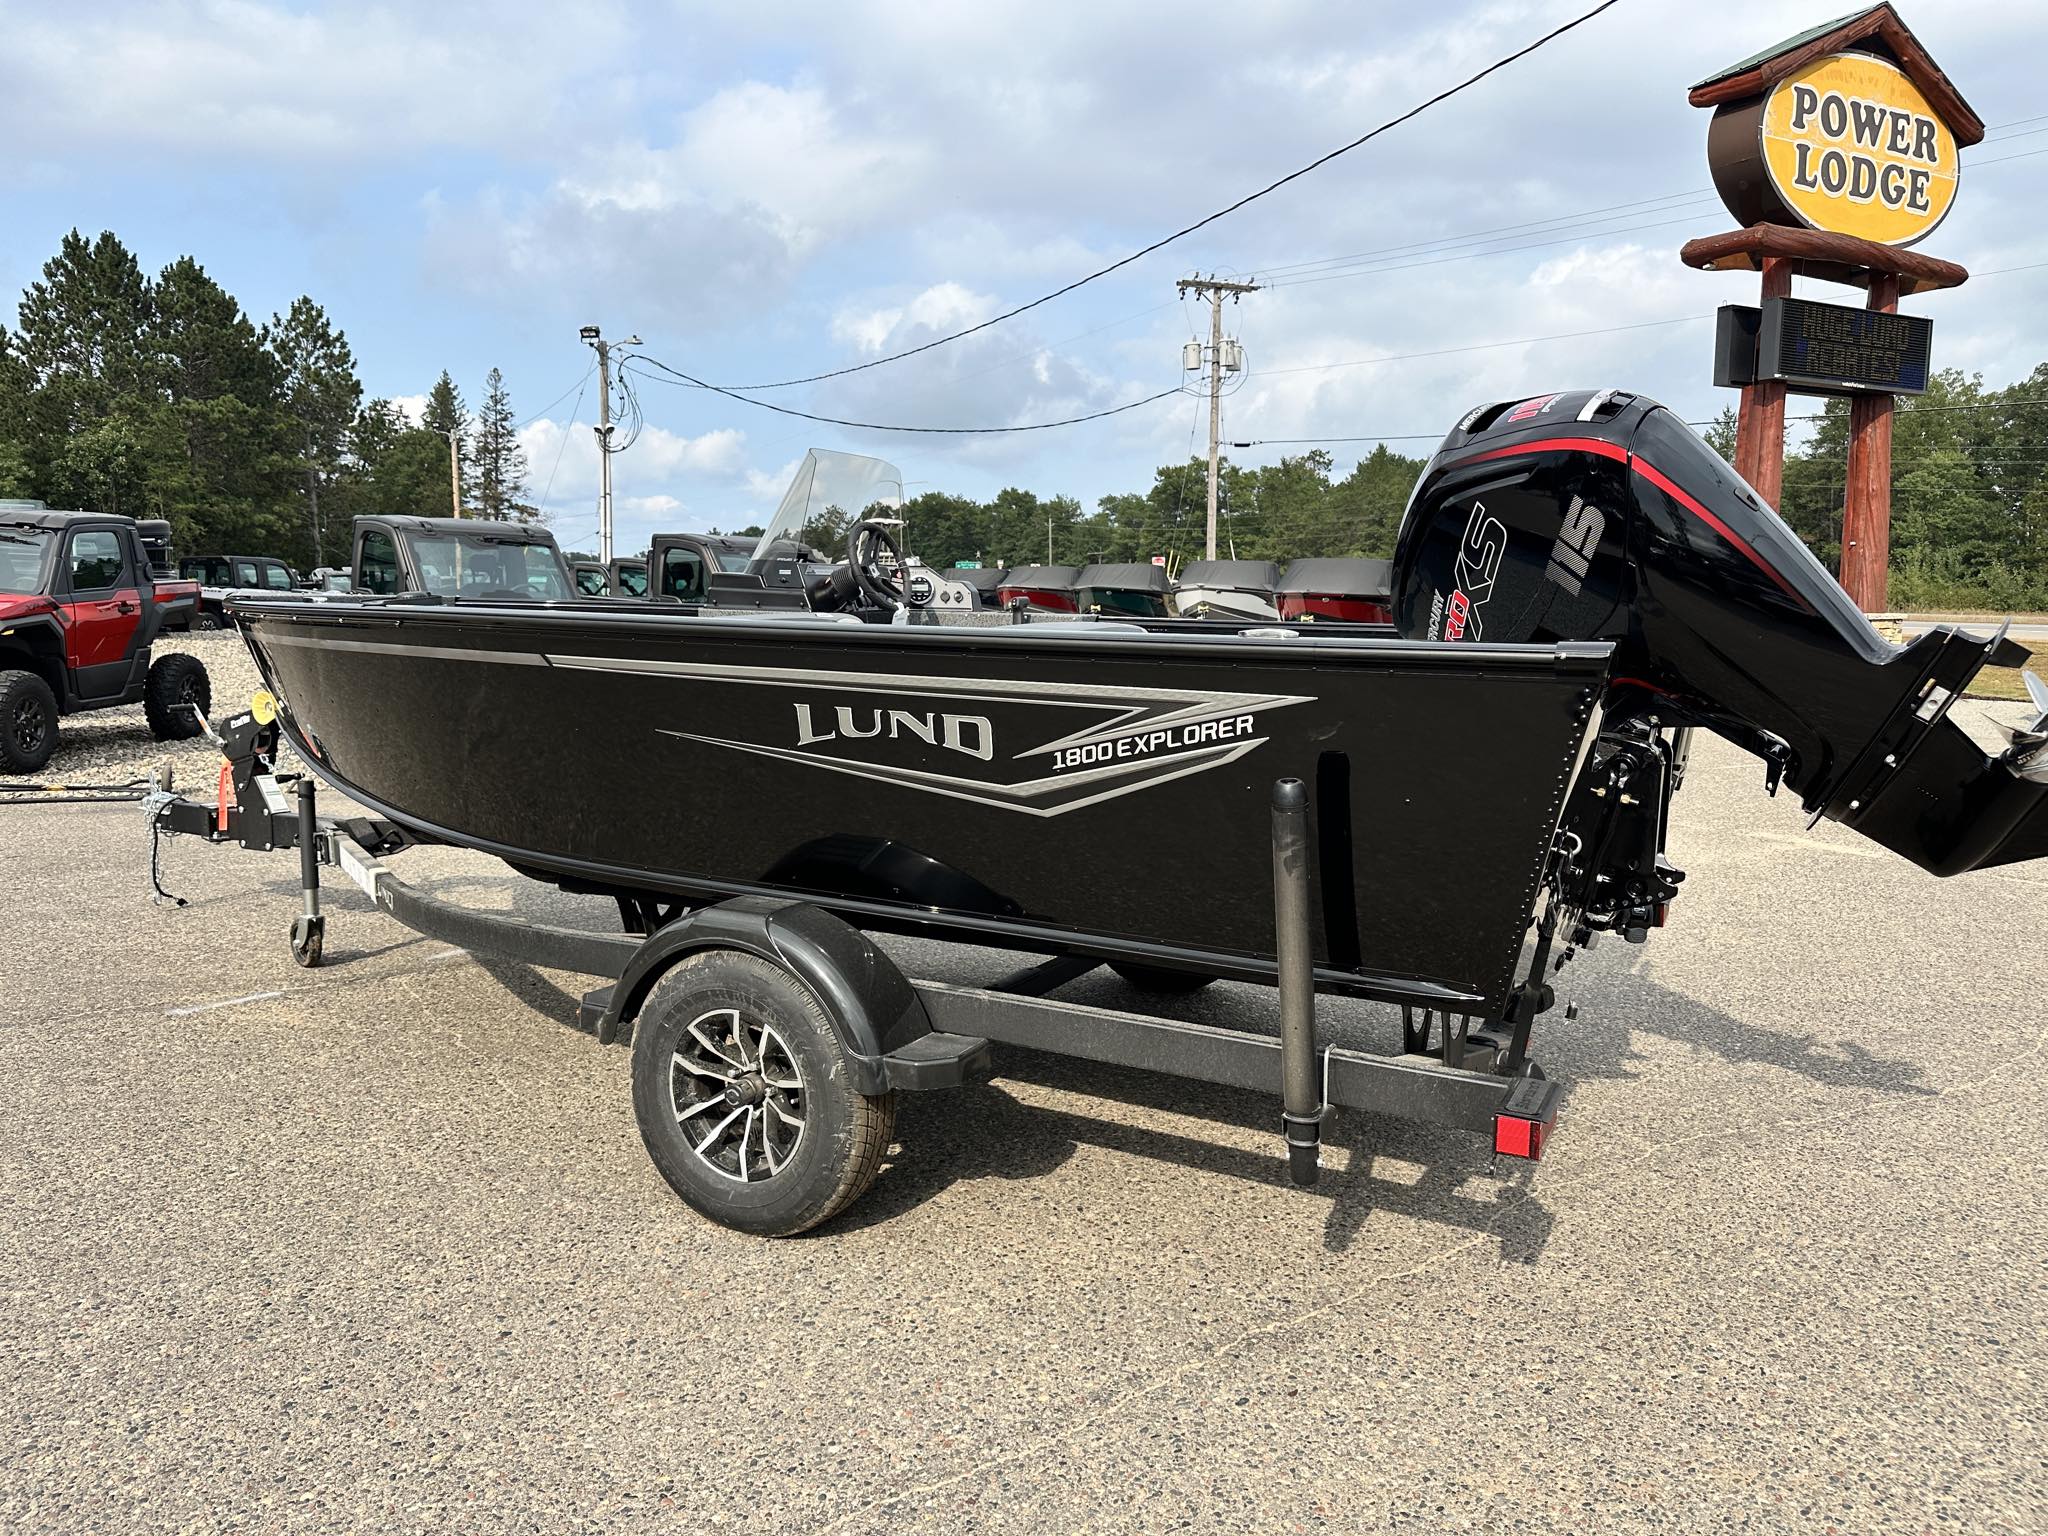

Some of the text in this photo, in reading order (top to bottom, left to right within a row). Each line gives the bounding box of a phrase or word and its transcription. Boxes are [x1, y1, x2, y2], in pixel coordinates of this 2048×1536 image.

[1792, 86, 1938, 163] POWER
[1794, 143, 1932, 212] LODGE
[1545, 495, 1606, 597] 115
[1427, 588, 1445, 641] RCURY
[794, 703, 993, 761] LUND
[1052, 714, 1254, 770] 1800 EXPLORER
